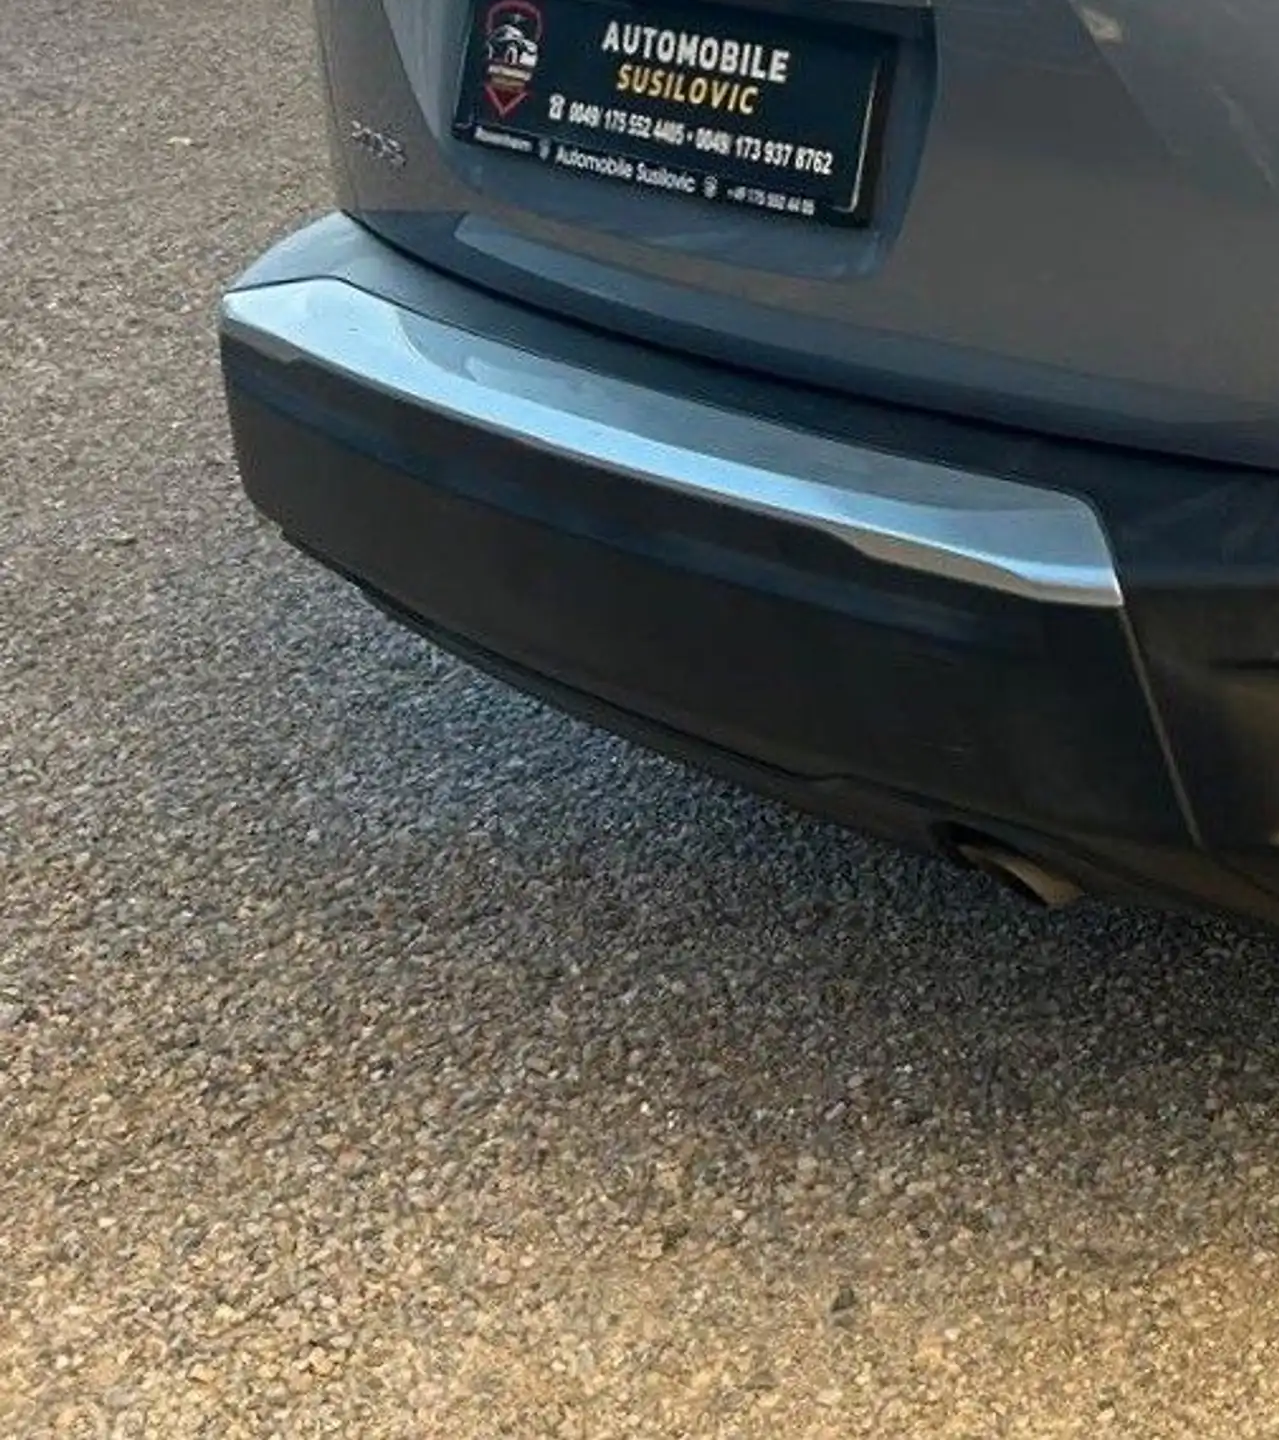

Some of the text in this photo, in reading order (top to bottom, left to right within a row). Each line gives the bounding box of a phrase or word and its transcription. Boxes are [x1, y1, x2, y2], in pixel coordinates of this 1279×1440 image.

[602, 21, 791, 83] AUTOMOBILE
[616, 62, 759, 115] SUSILOVIC
[555, 145, 696, 193] Automobile Susilovic
[604, 109, 627, 133] 175
[628, 113, 652, 139] 552
[735, 135, 761, 161] 173
[764, 140, 794, 167] 937
[795, 146, 833, 175] 8762
